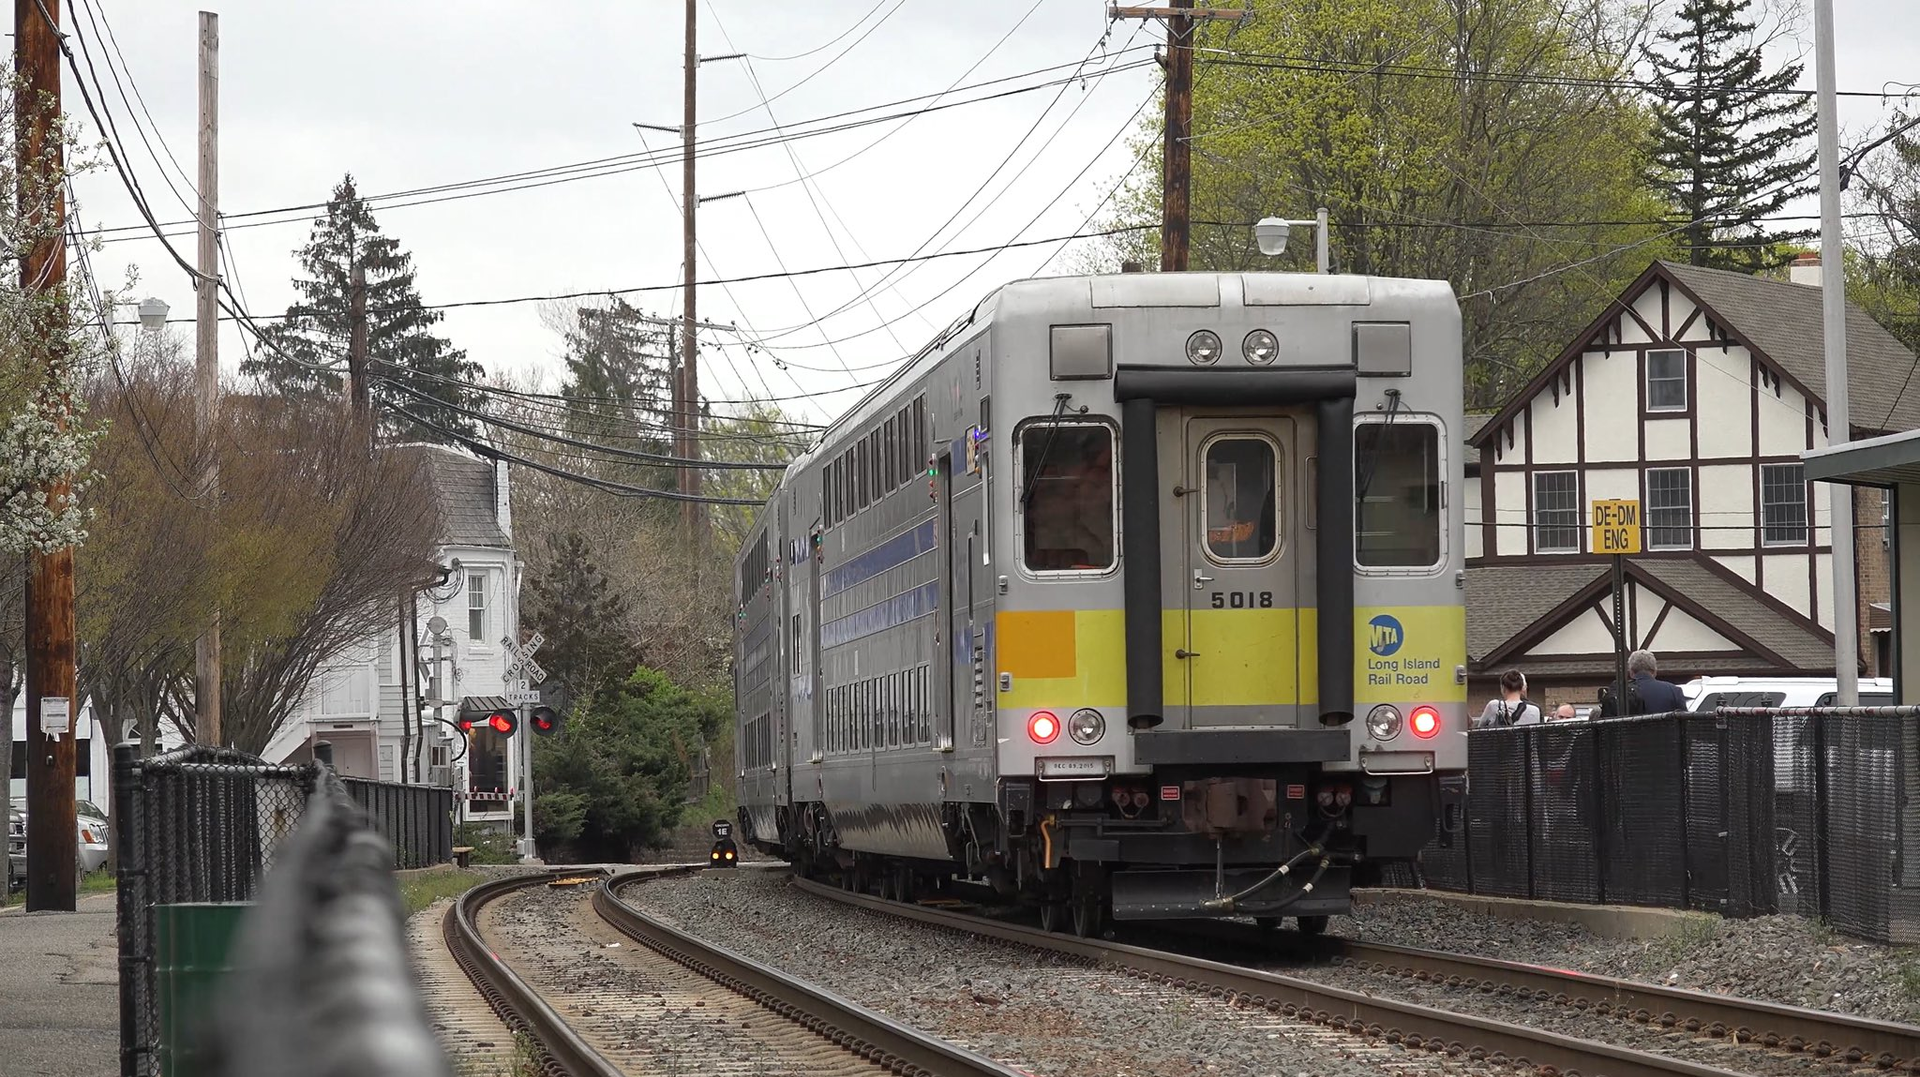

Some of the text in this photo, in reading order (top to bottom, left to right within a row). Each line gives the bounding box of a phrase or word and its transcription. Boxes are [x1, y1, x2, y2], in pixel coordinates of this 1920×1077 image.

[1595, 505, 1636, 526] DE-DM
[1604, 528, 1629, 550] ENG
[1211, 591, 1273, 609] 5018
[1369, 624, 1398, 649] MTA
[502, 635, 542, 683] CROSSING
[1368, 658, 1440, 672] Long Island
[520, 681, 526, 690] 2
[1368, 673, 1428, 685] Rail Road
[717, 828, 728, 836] 1E
